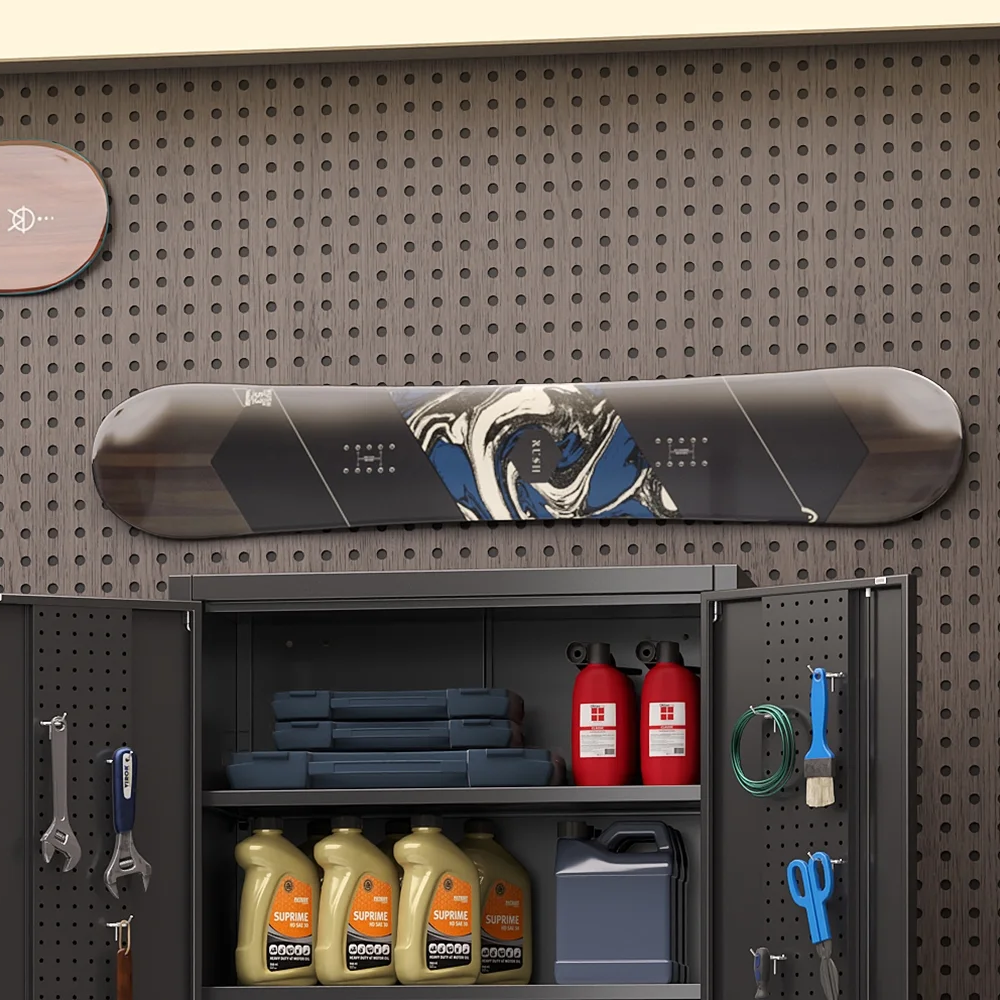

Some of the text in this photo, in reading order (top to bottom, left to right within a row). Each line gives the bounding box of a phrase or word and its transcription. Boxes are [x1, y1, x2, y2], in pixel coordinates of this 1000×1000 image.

[274, 912, 309, 922] SUPRIME
[353, 911, 388, 921] SUPRIME
[434, 910, 468, 920] SUPRIME
[485, 915, 519, 925] SUPRIME
